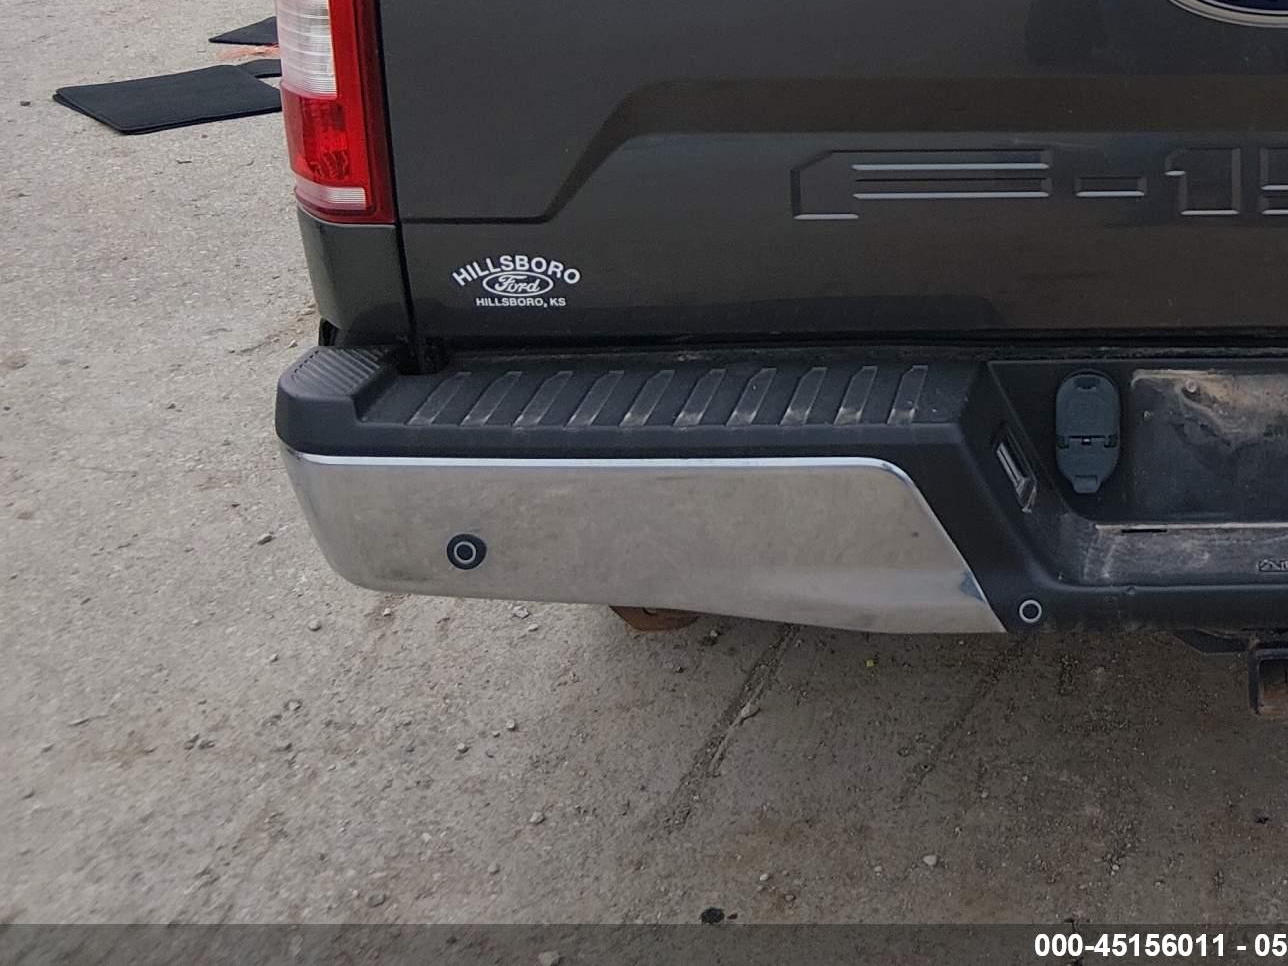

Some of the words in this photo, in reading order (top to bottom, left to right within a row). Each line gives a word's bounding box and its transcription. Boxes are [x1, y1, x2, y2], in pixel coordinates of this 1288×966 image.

[452, 255, 581, 287] HILLSBORO
[494, 274, 541, 294] Ford
[476, 297, 548, 308] HILLSBORO,
[549, 297, 567, 307] KS
